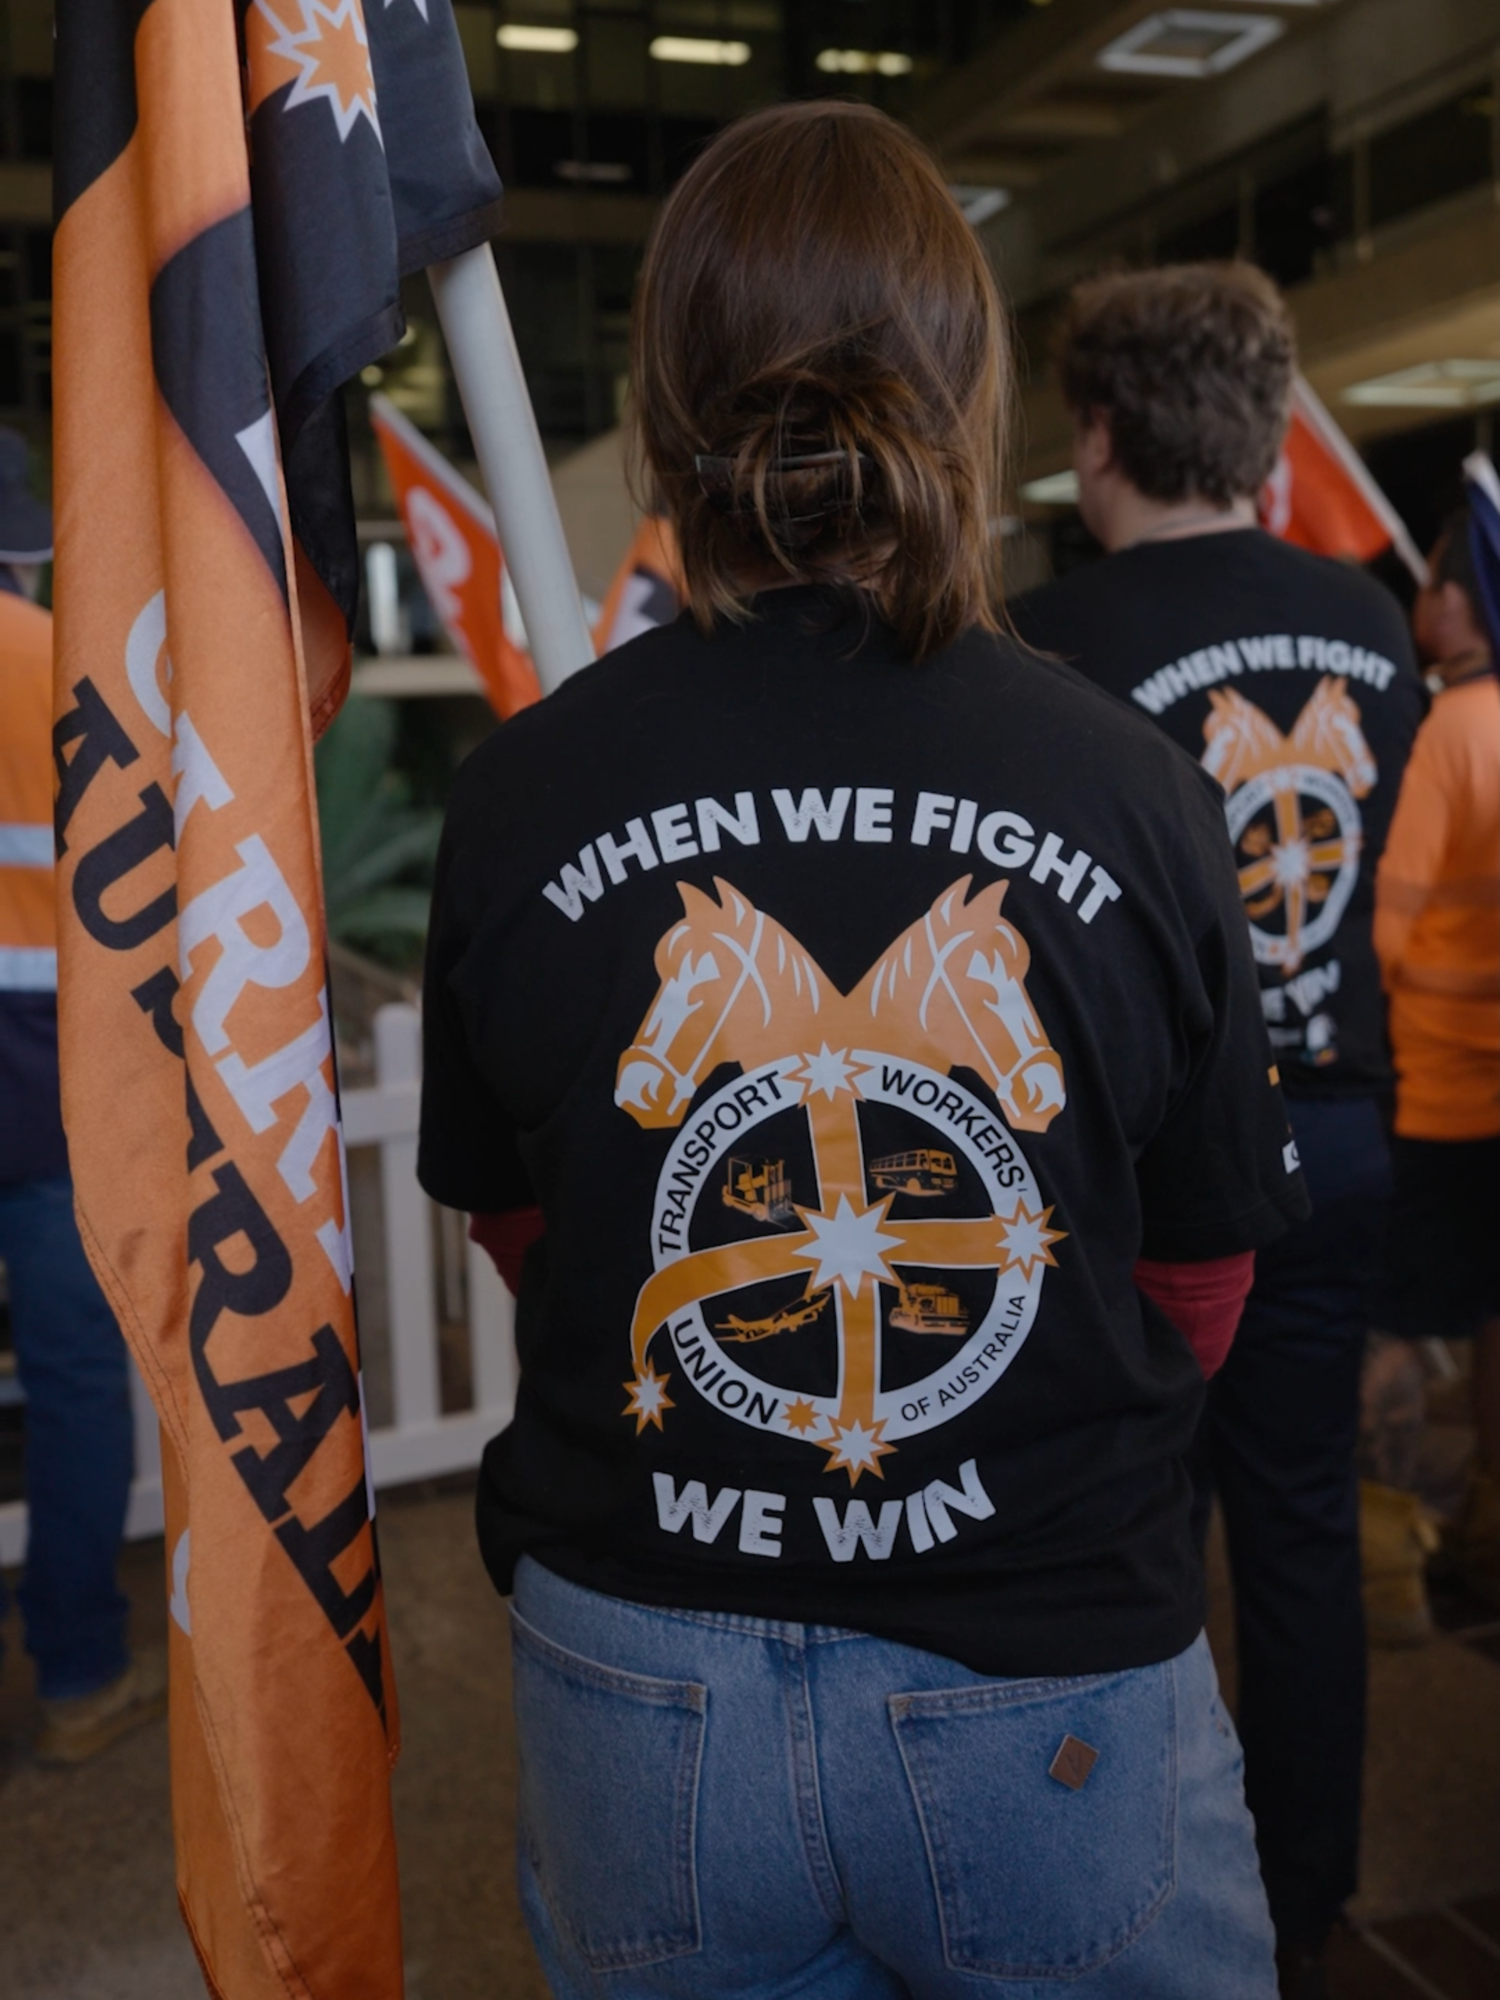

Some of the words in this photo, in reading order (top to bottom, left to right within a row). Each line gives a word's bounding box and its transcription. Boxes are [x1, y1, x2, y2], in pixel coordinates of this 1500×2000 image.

[1131, 639, 1244, 715] WHEN
[1237, 633, 1297, 673] WE
[1297, 635, 1397, 693] FIGHT
[541, 791, 761, 922] WHEN
[771, 787, 895, 843] WE
[910, 791, 1122, 925] FIGHT
[659, 1070, 784, 1254] TRANSPORT
[675, 1318, 780, 1426] UNION
[900, 1396, 933, 1423] OF
[938, 1294, 1027, 1408] AUSTRALIA
[652, 1471, 787, 1559] WE
[812, 1458, 997, 1563] WIN
